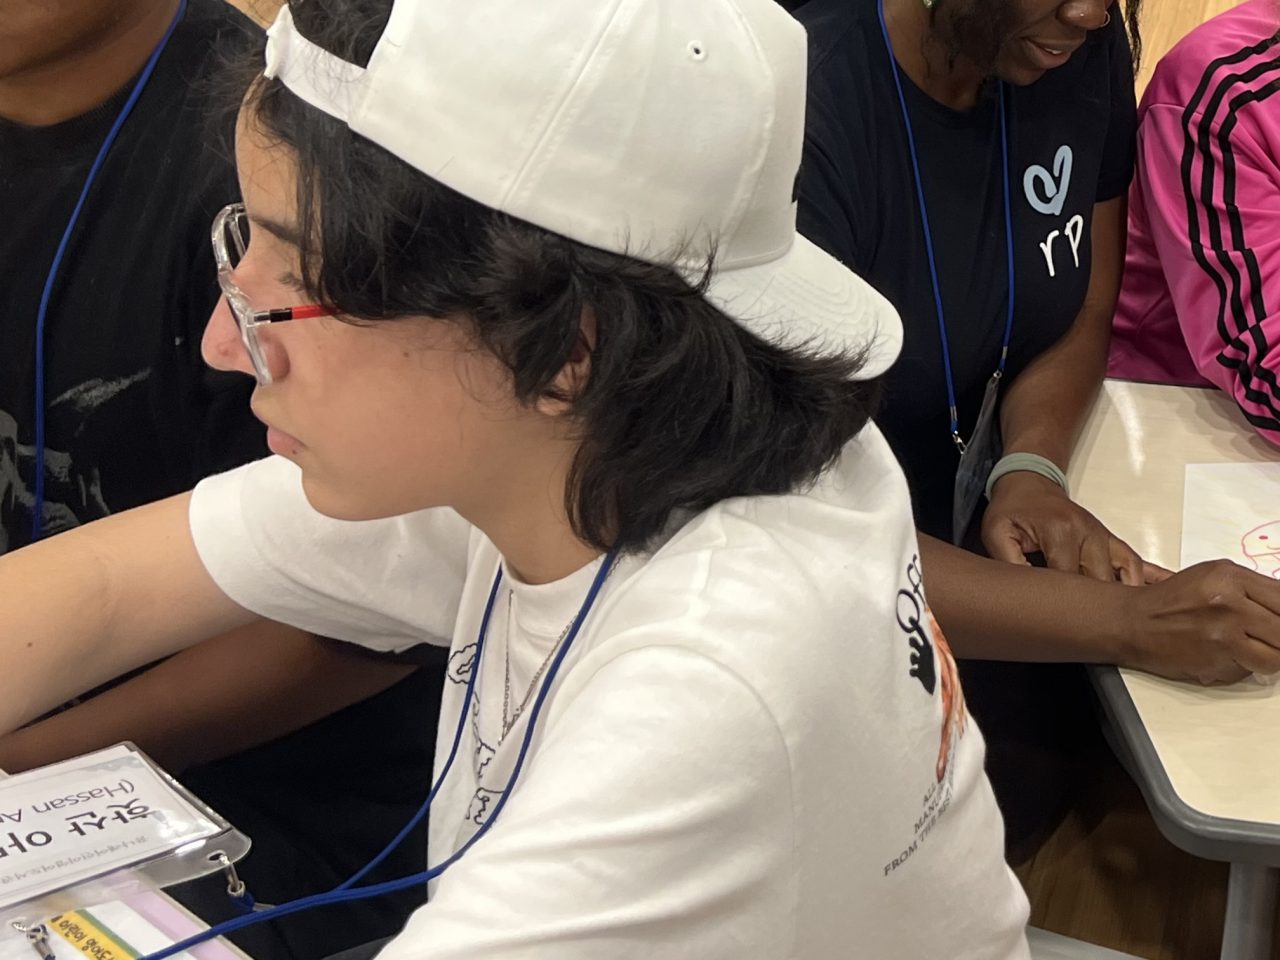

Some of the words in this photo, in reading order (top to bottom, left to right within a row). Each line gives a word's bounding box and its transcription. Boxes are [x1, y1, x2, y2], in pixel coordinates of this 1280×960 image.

[1040, 213, 1085, 278] rp
[31, 778, 135, 814] (Hassan
[65, 797, 151, 837] 핫산
[884, 840, 918, 877] FROM
[919, 815, 937, 842] THE
